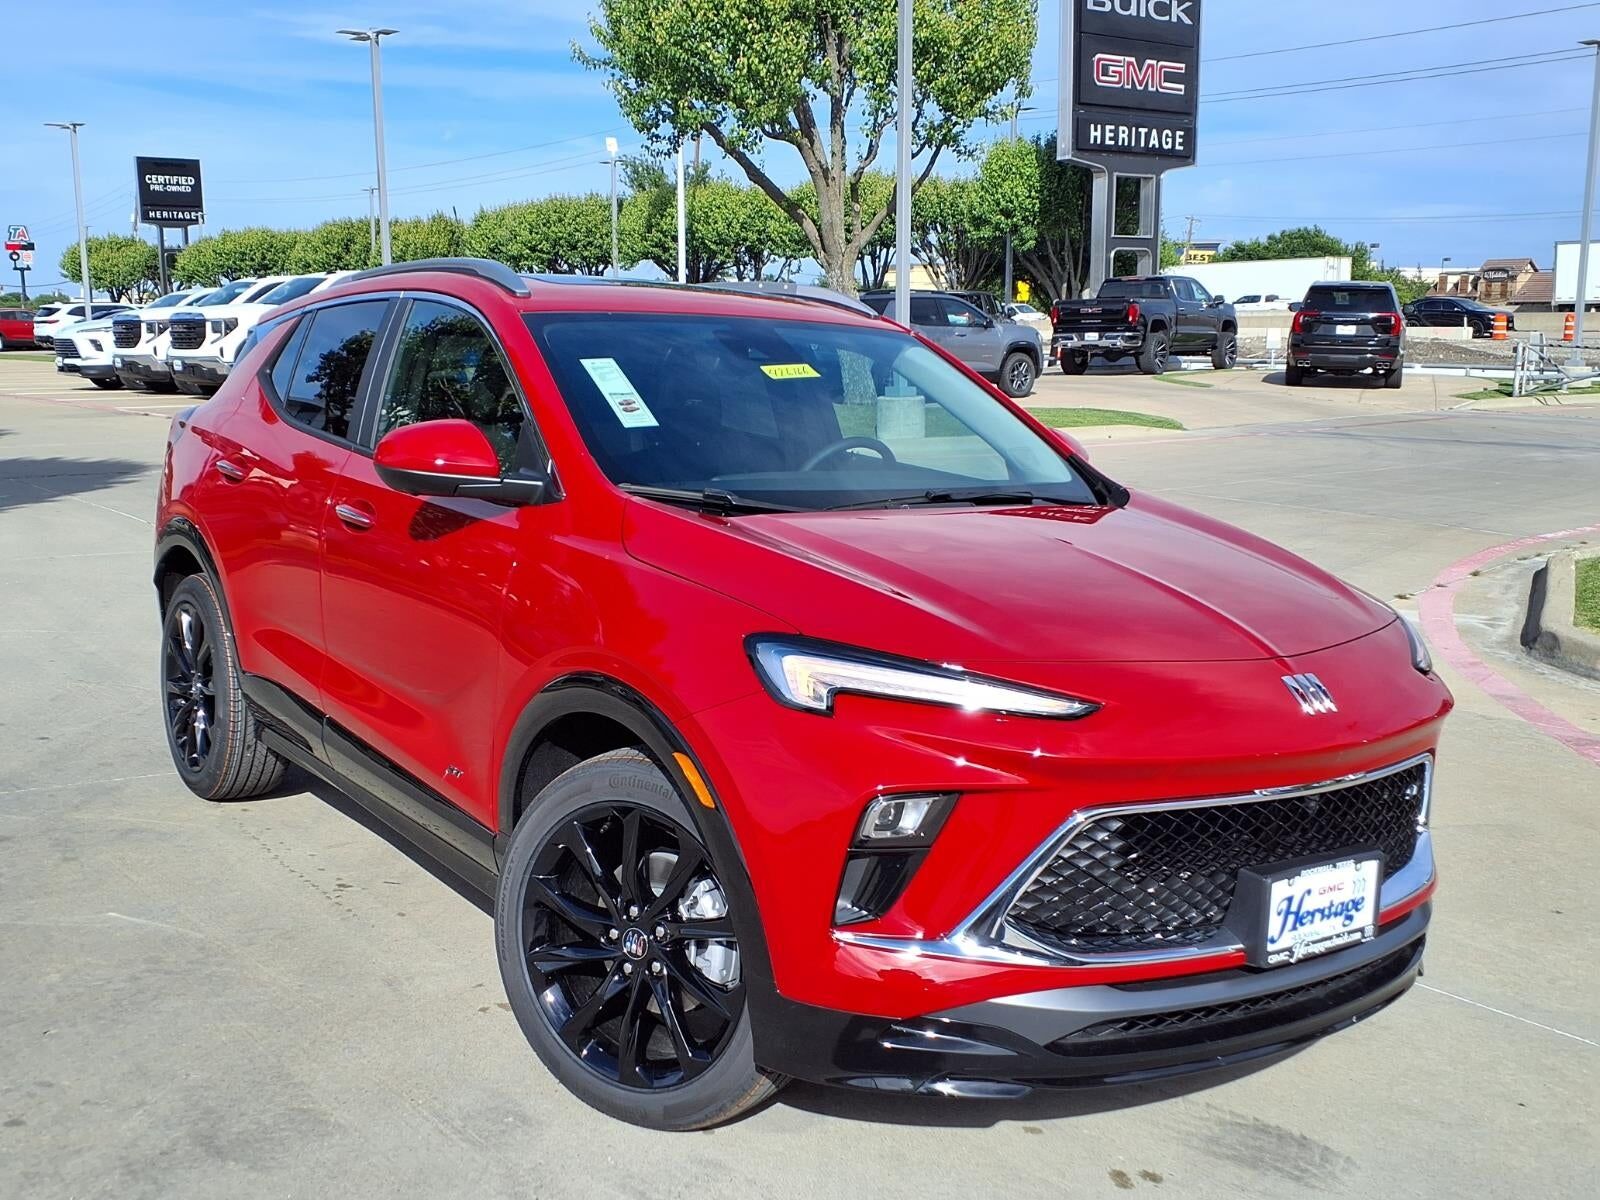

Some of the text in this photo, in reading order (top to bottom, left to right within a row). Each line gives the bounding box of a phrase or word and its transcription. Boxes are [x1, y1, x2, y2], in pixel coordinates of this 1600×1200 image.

[1093, 53, 1186, 95] GMC
[1089, 123, 1185, 150] HERITAGE
[145, 174, 195, 185] CERTIFIED
[150, 184, 192, 192] PRE-OWNED
[148, 210, 197, 220] HERITAGE
[9, 225, 29, 241] TA
[608, 774, 675, 800] Continental
[1318, 882, 1345, 896] GMC
[1268, 888, 1365, 944] Heritage
